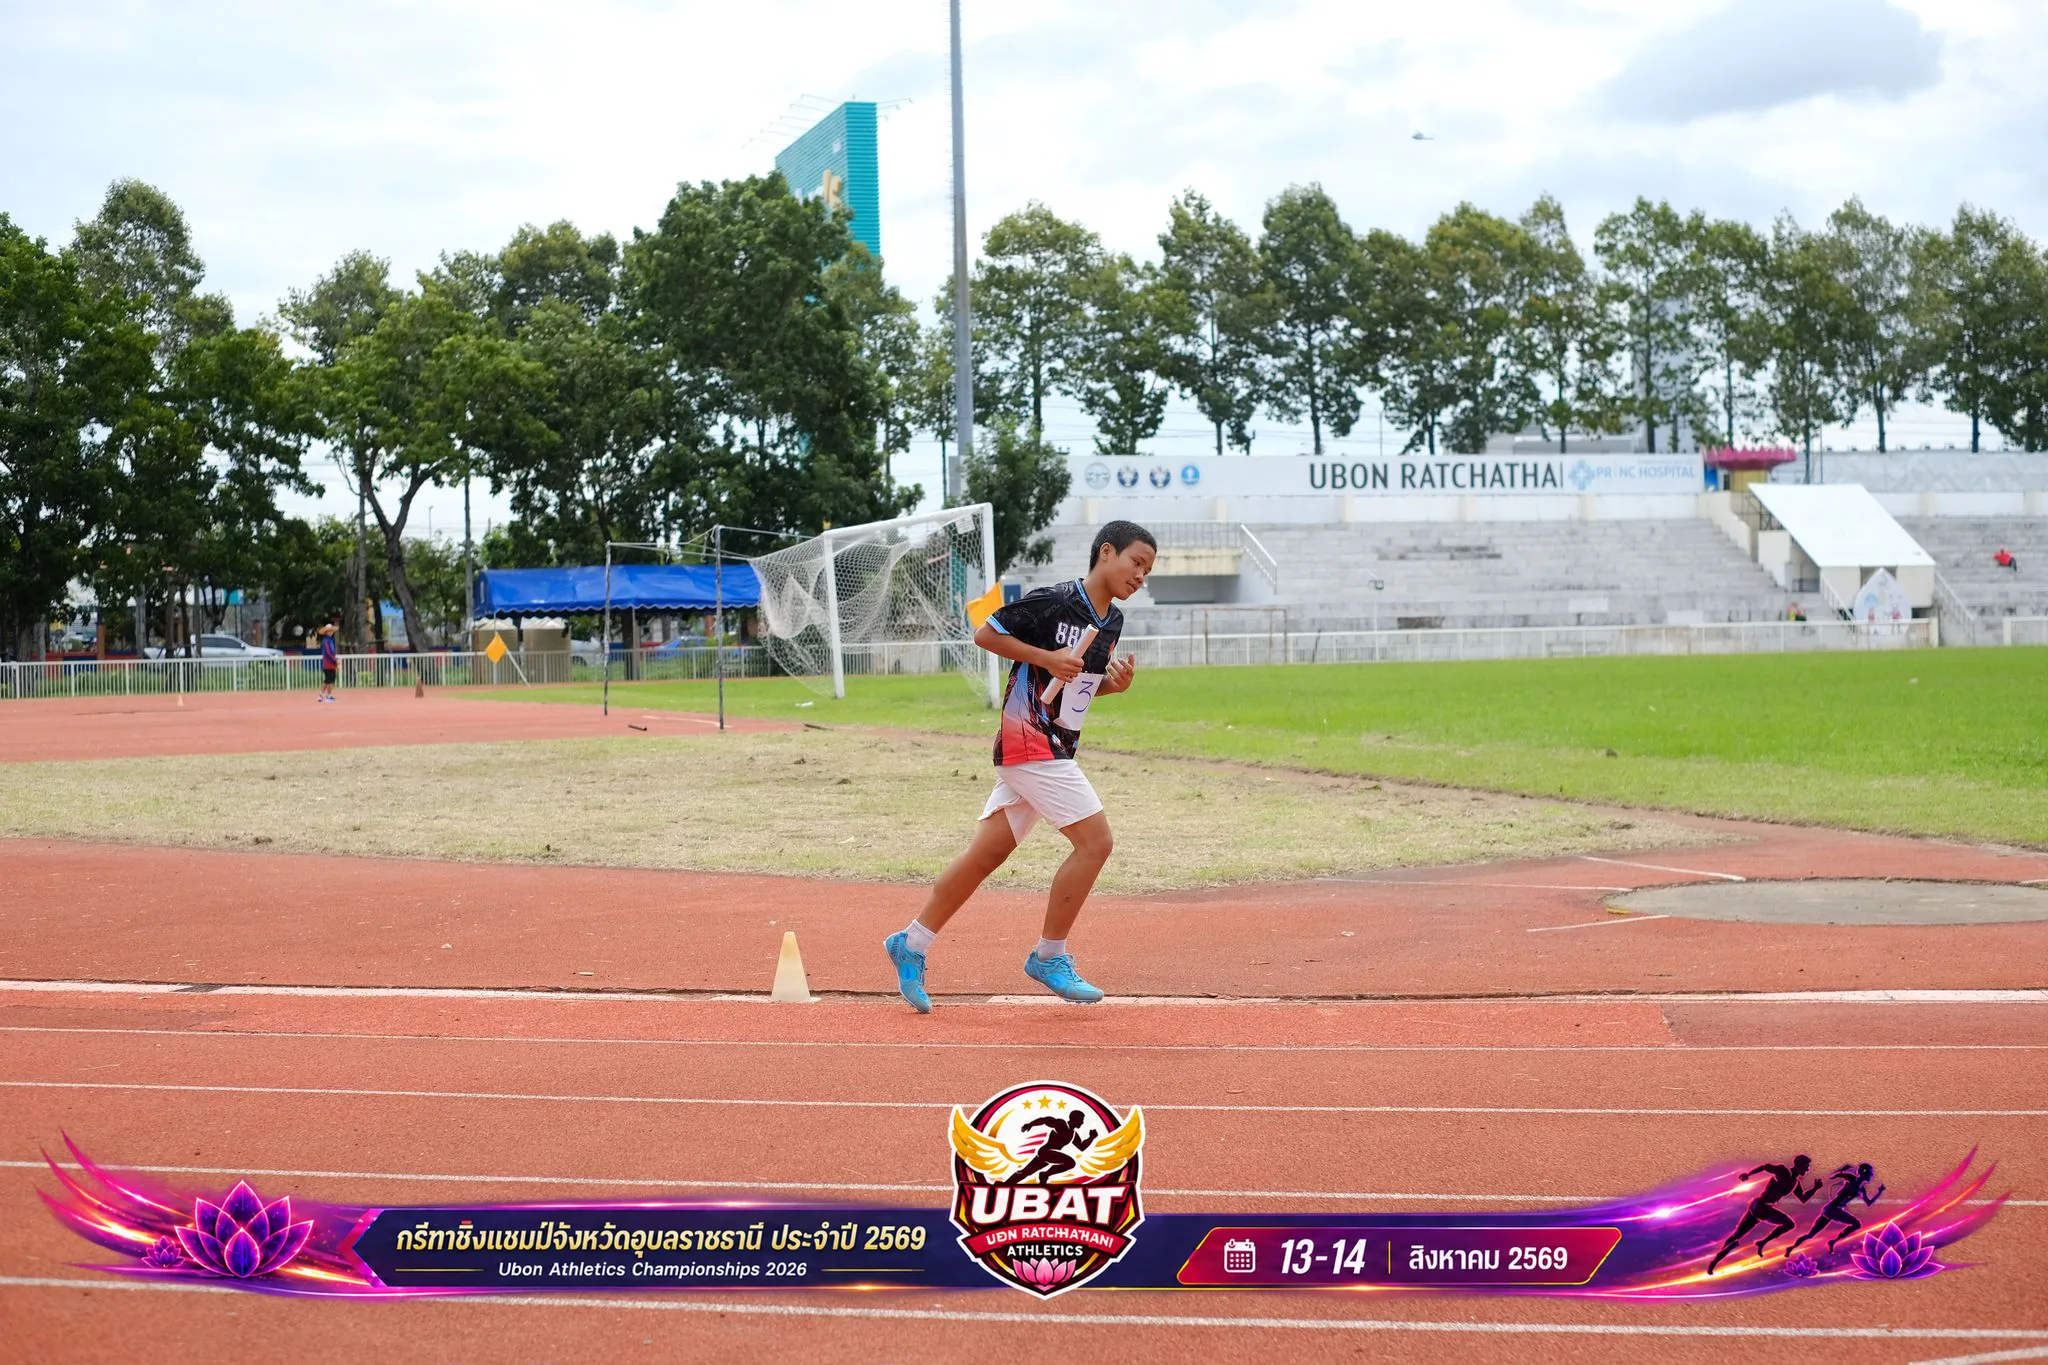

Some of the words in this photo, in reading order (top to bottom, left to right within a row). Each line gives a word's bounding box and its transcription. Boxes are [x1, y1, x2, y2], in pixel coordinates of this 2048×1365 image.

[1310, 463, 1389, 489] UBON
[1639, 466, 1696, 479] HOSPITAL
[1071, 680, 1094, 713] 3
